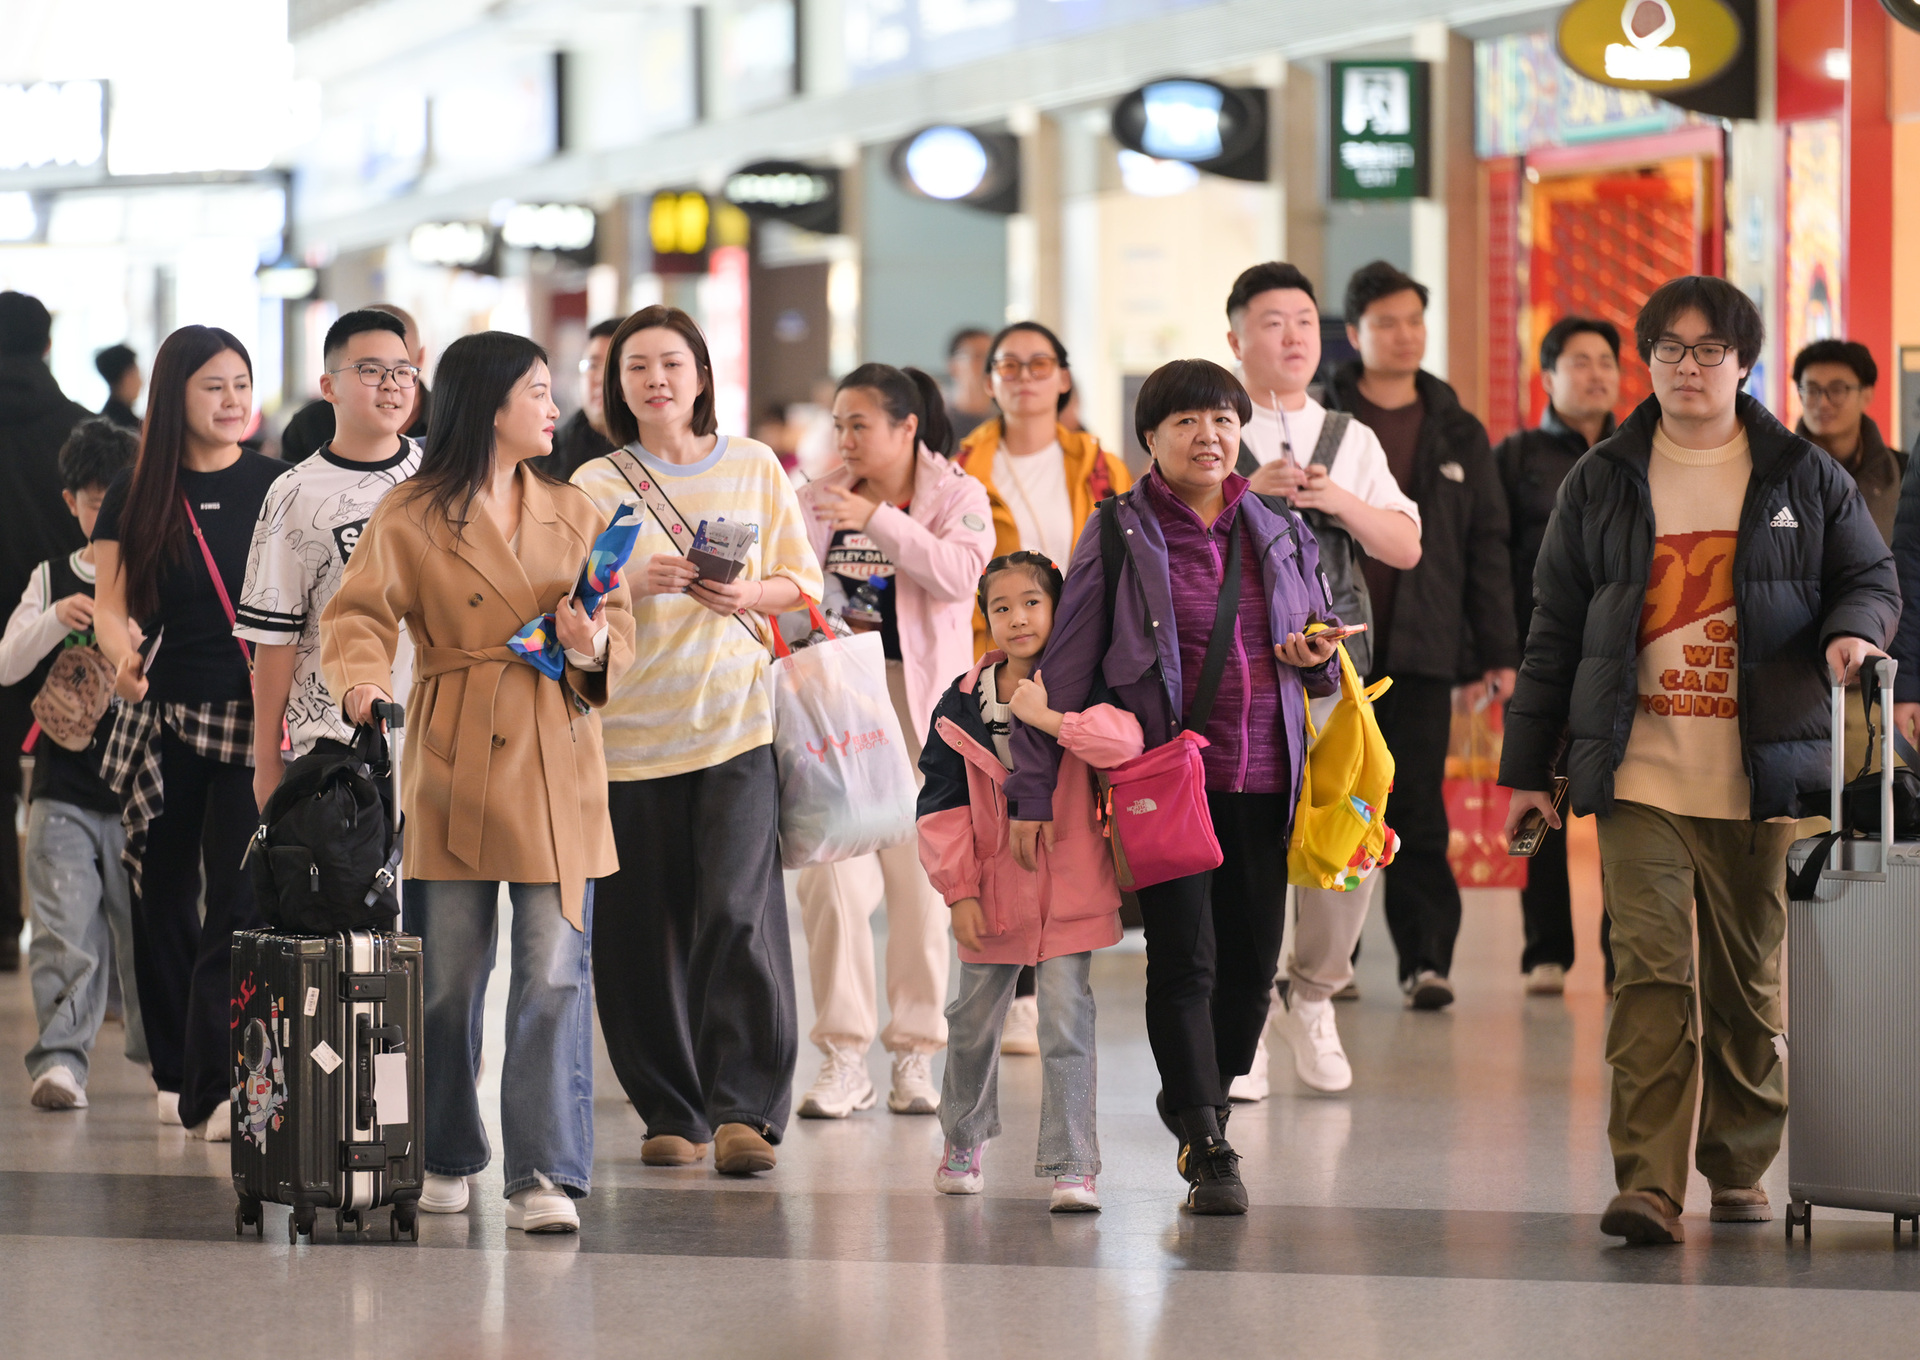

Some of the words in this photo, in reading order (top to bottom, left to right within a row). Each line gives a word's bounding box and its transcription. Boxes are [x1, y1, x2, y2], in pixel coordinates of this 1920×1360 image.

[1770, 519, 1799, 528] adidas
[1683, 644, 1735, 669] WE
[1659, 669, 1729, 693] CAN
